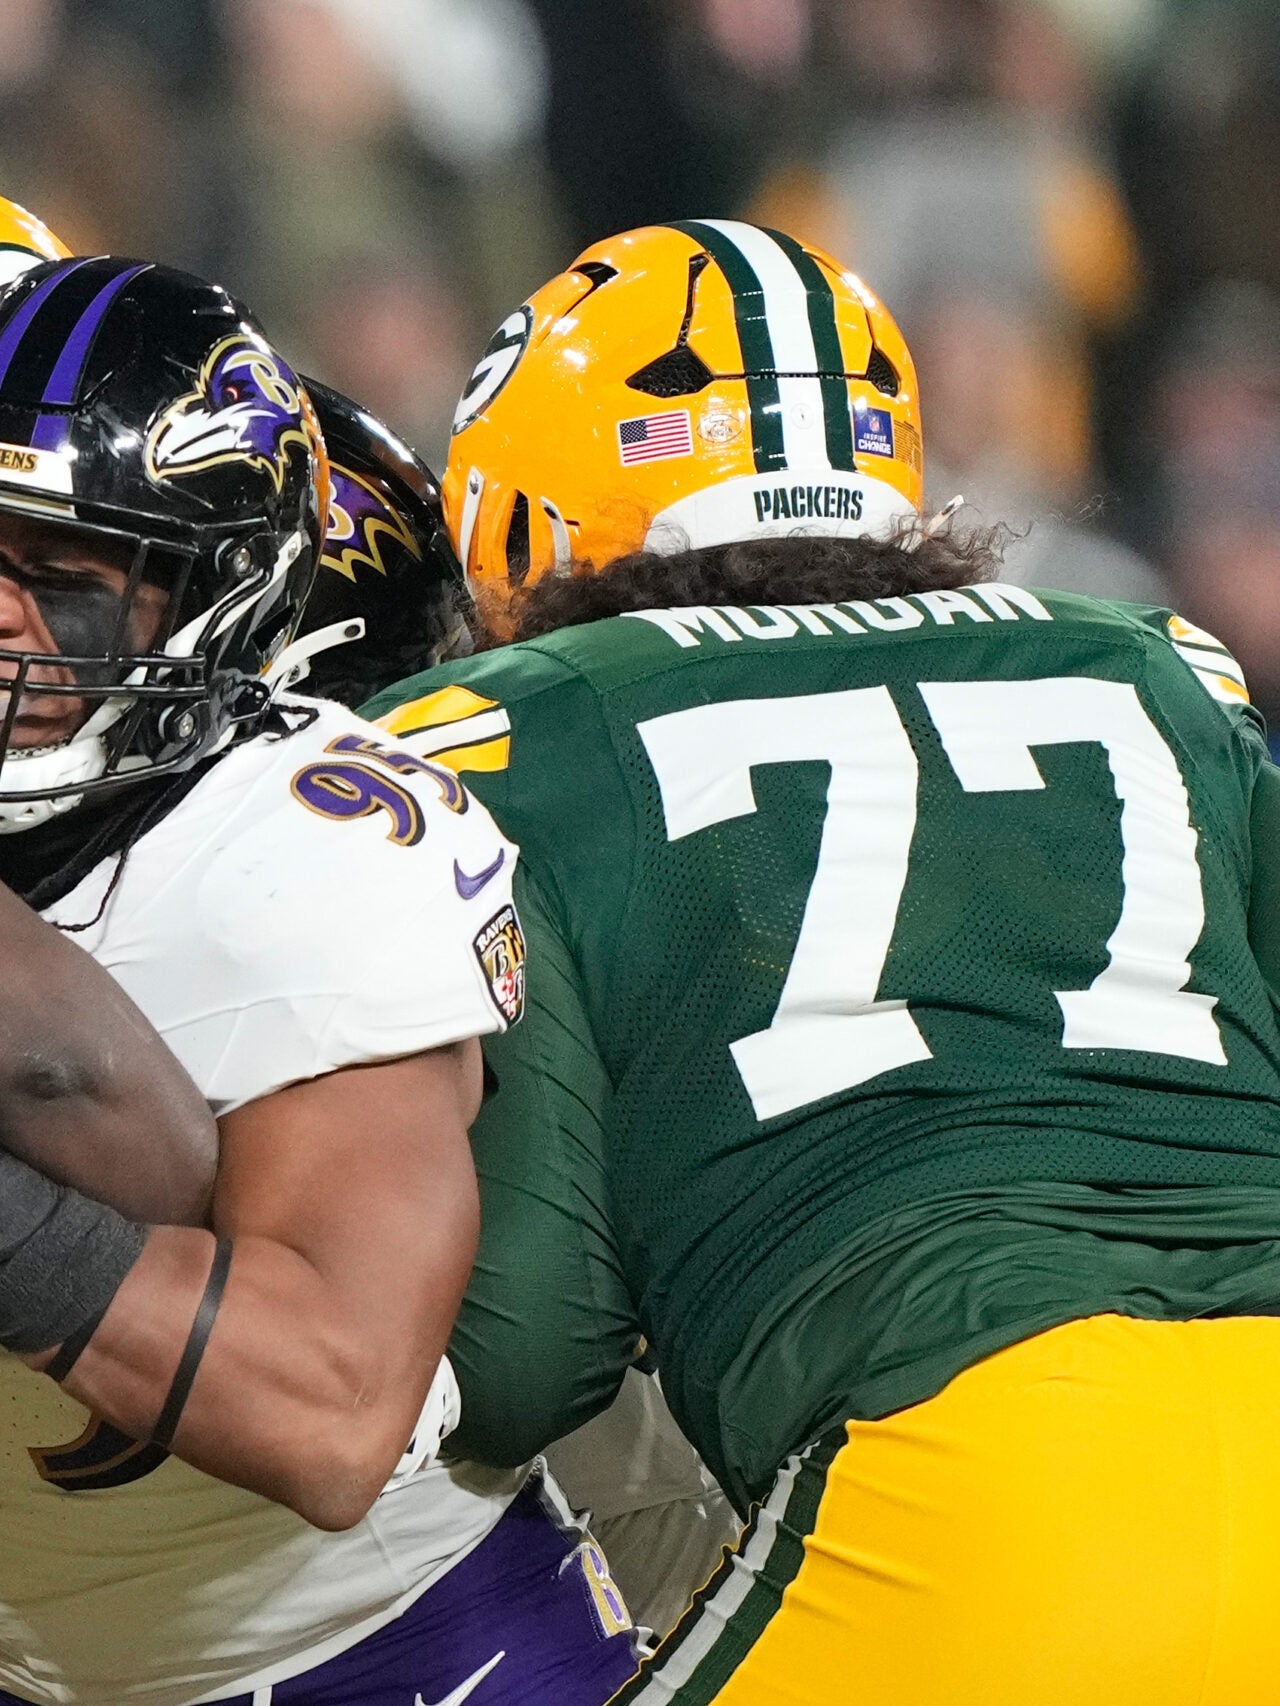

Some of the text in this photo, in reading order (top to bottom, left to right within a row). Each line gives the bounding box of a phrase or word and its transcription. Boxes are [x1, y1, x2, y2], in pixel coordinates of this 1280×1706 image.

[858, 439, 892, 454] CHANGE
[753, 485, 864, 522] PACKERS
[290, 732, 470, 847] 95
[636, 675, 1229, 1123] 77
